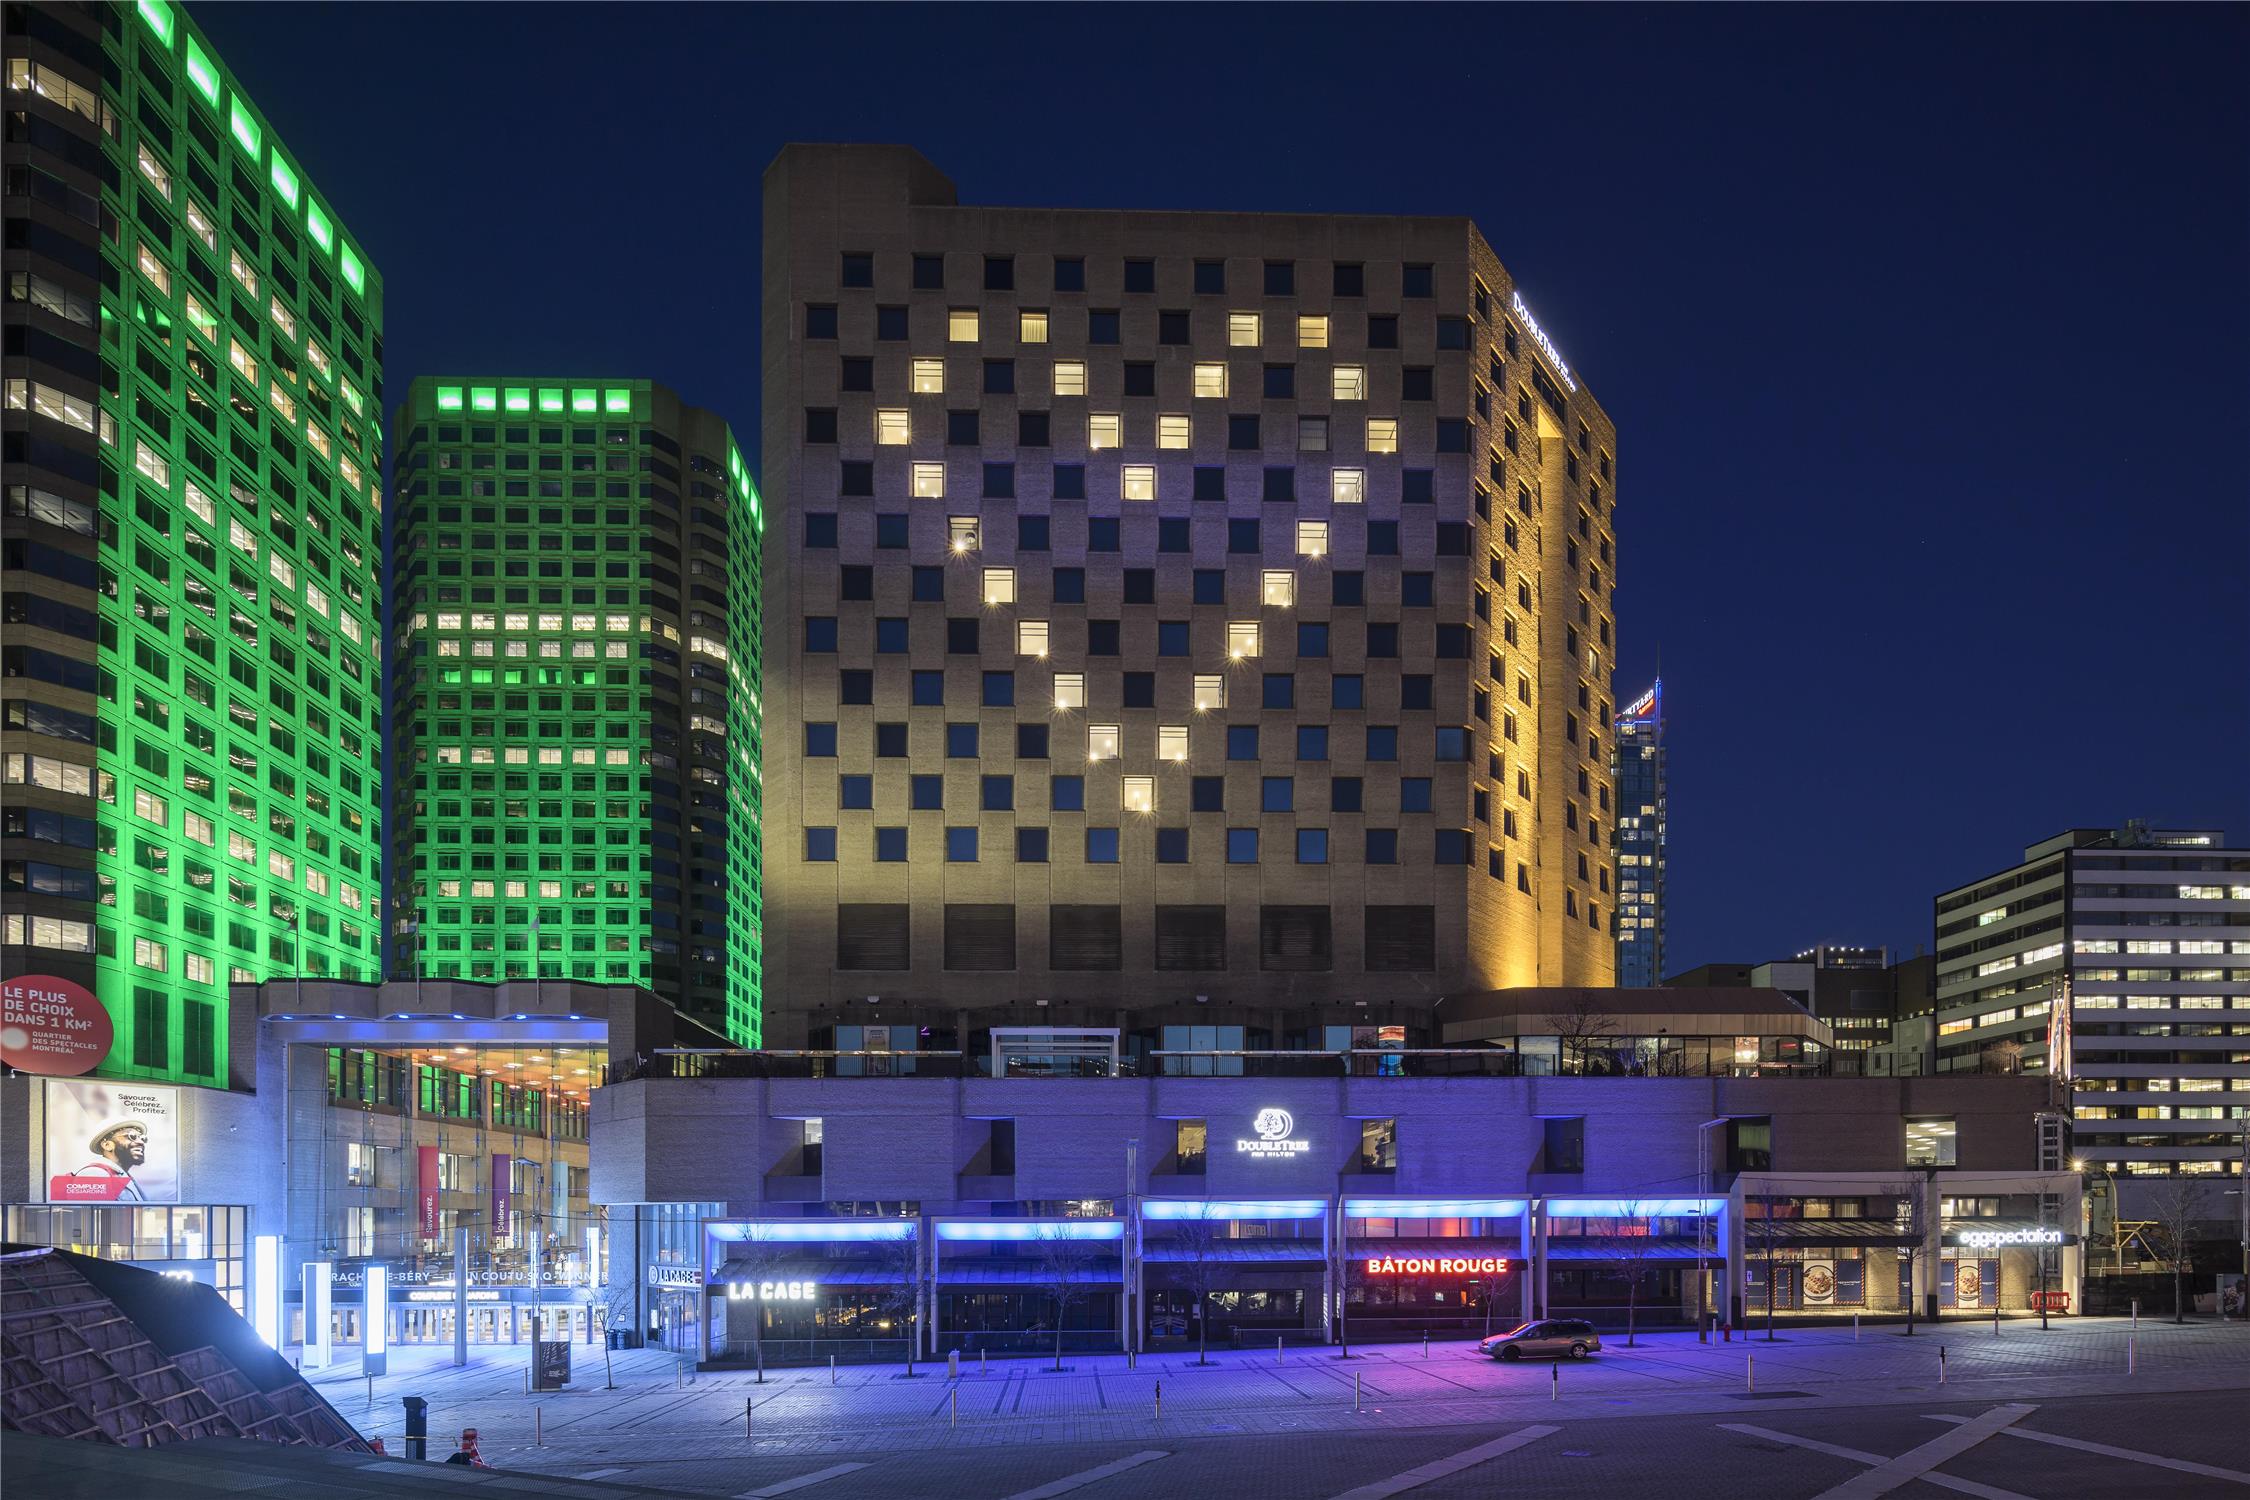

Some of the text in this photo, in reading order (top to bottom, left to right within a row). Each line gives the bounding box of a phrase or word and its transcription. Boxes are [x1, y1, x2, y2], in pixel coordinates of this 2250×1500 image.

[4, 986, 67, 1004] LE PLUS
[4, 999, 74, 1017] DE CHOIX
[4, 1012, 46, 1026] DANS
[50, 1017, 60, 1028] 1
[32, 1031, 72, 1041] QUARTIER
[50, 1039, 97, 1050] SPECTACLES
[425, 1195, 433, 1233] Savourez.
[1960, 1227, 2062, 1248] eggspectation
[1367, 1255, 1508, 1273] BÂTON ROUGE
[660, 1269, 694, 1284] LA CAGE
[728, 1281, 816, 1300] LA CAGE
